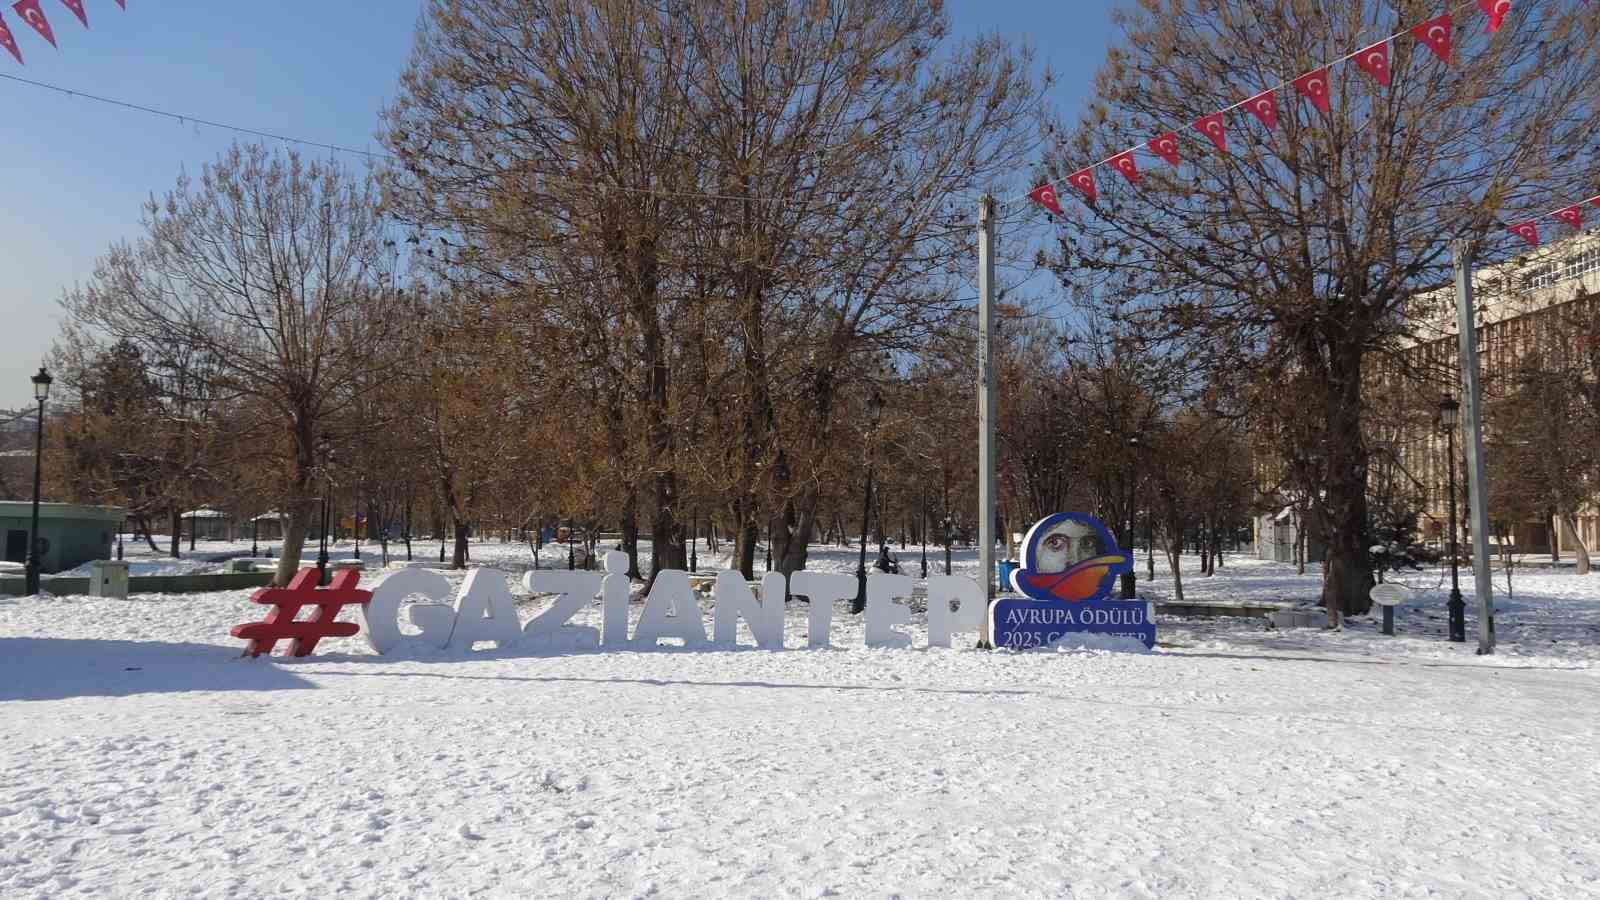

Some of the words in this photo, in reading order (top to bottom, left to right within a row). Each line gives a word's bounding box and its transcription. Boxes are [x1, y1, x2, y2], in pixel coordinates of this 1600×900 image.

[1005, 608, 1075, 625] AVRUPA
[1079, 607, 1143, 625] ÖDÜLÜ
[1003, 631, 1042, 648] 2025
